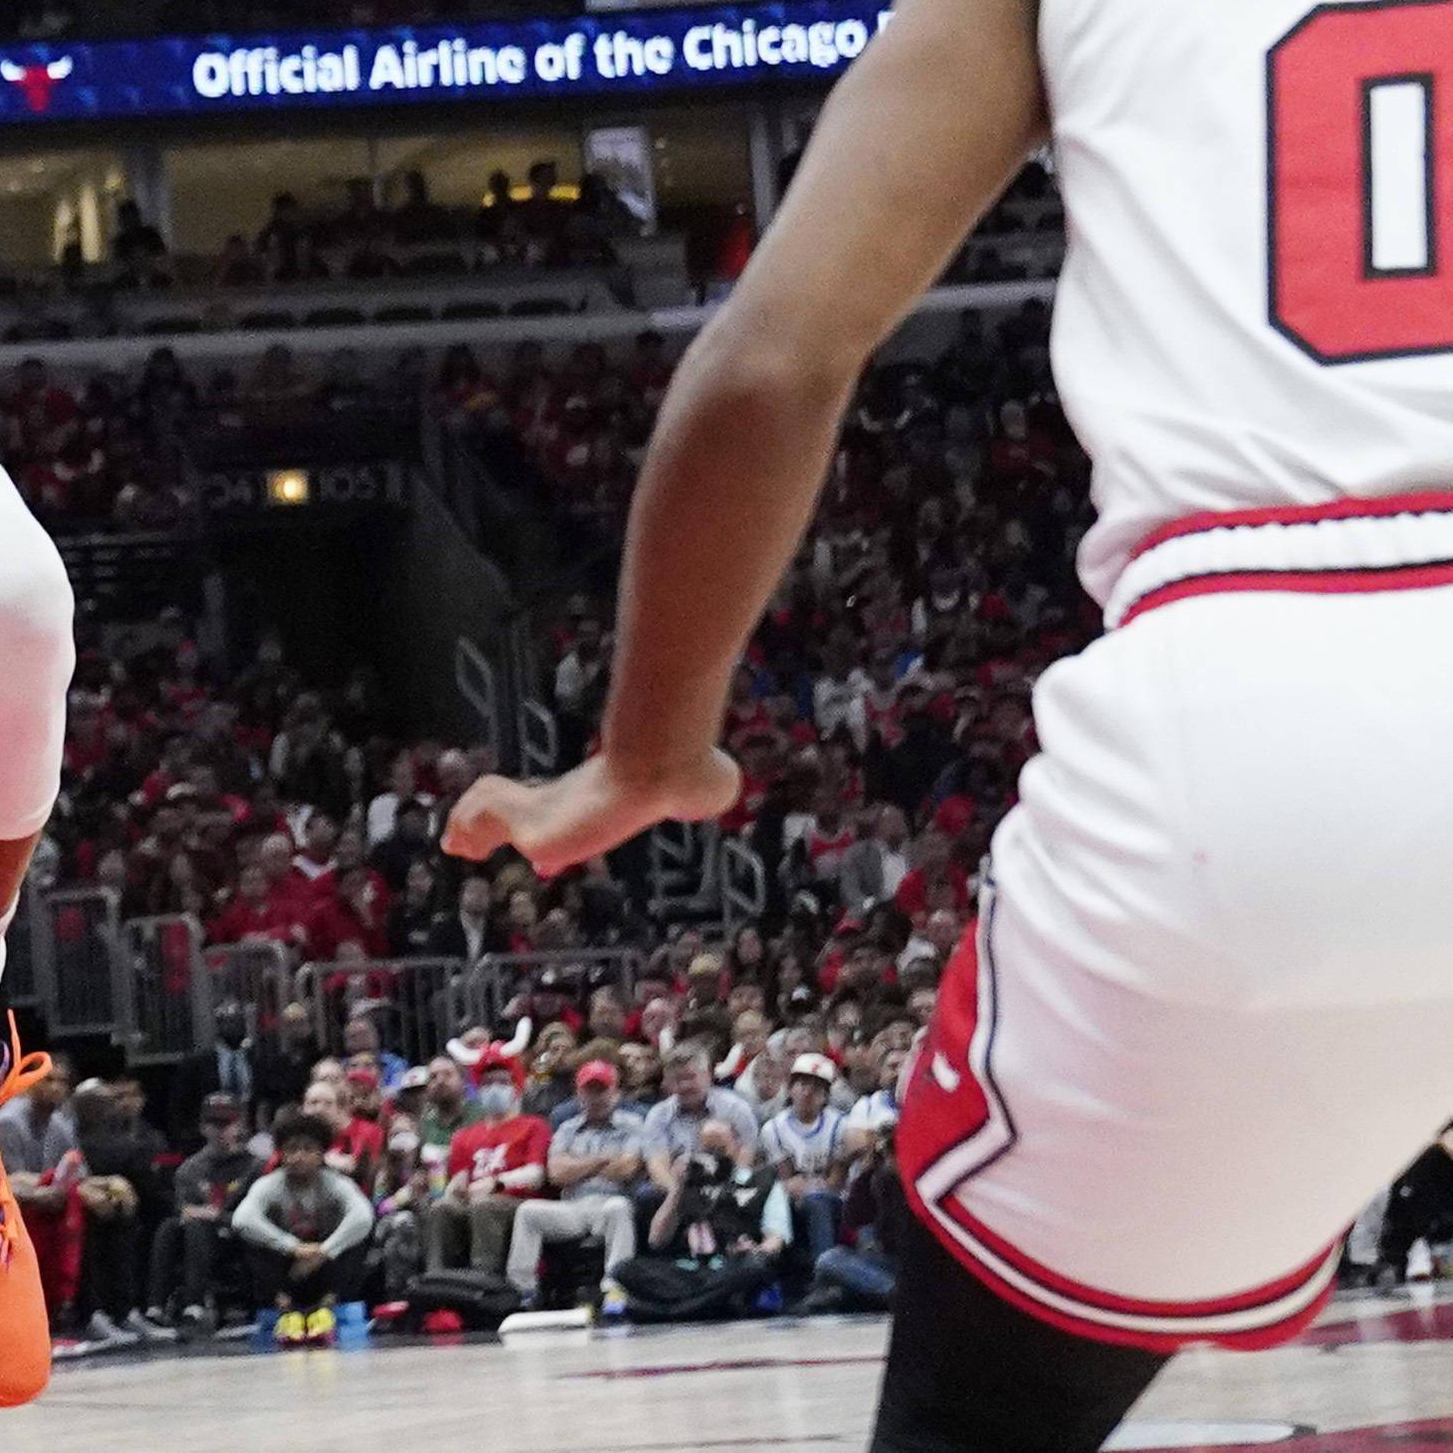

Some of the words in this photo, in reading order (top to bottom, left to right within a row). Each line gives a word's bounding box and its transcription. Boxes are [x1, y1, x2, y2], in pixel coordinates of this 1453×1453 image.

[192, 44, 361, 98] Official
[368, 37, 527, 90] Airline
[533, 31, 588, 82] of
[593, 30, 674, 78] the
[682, 17, 868, 71] Chicago
